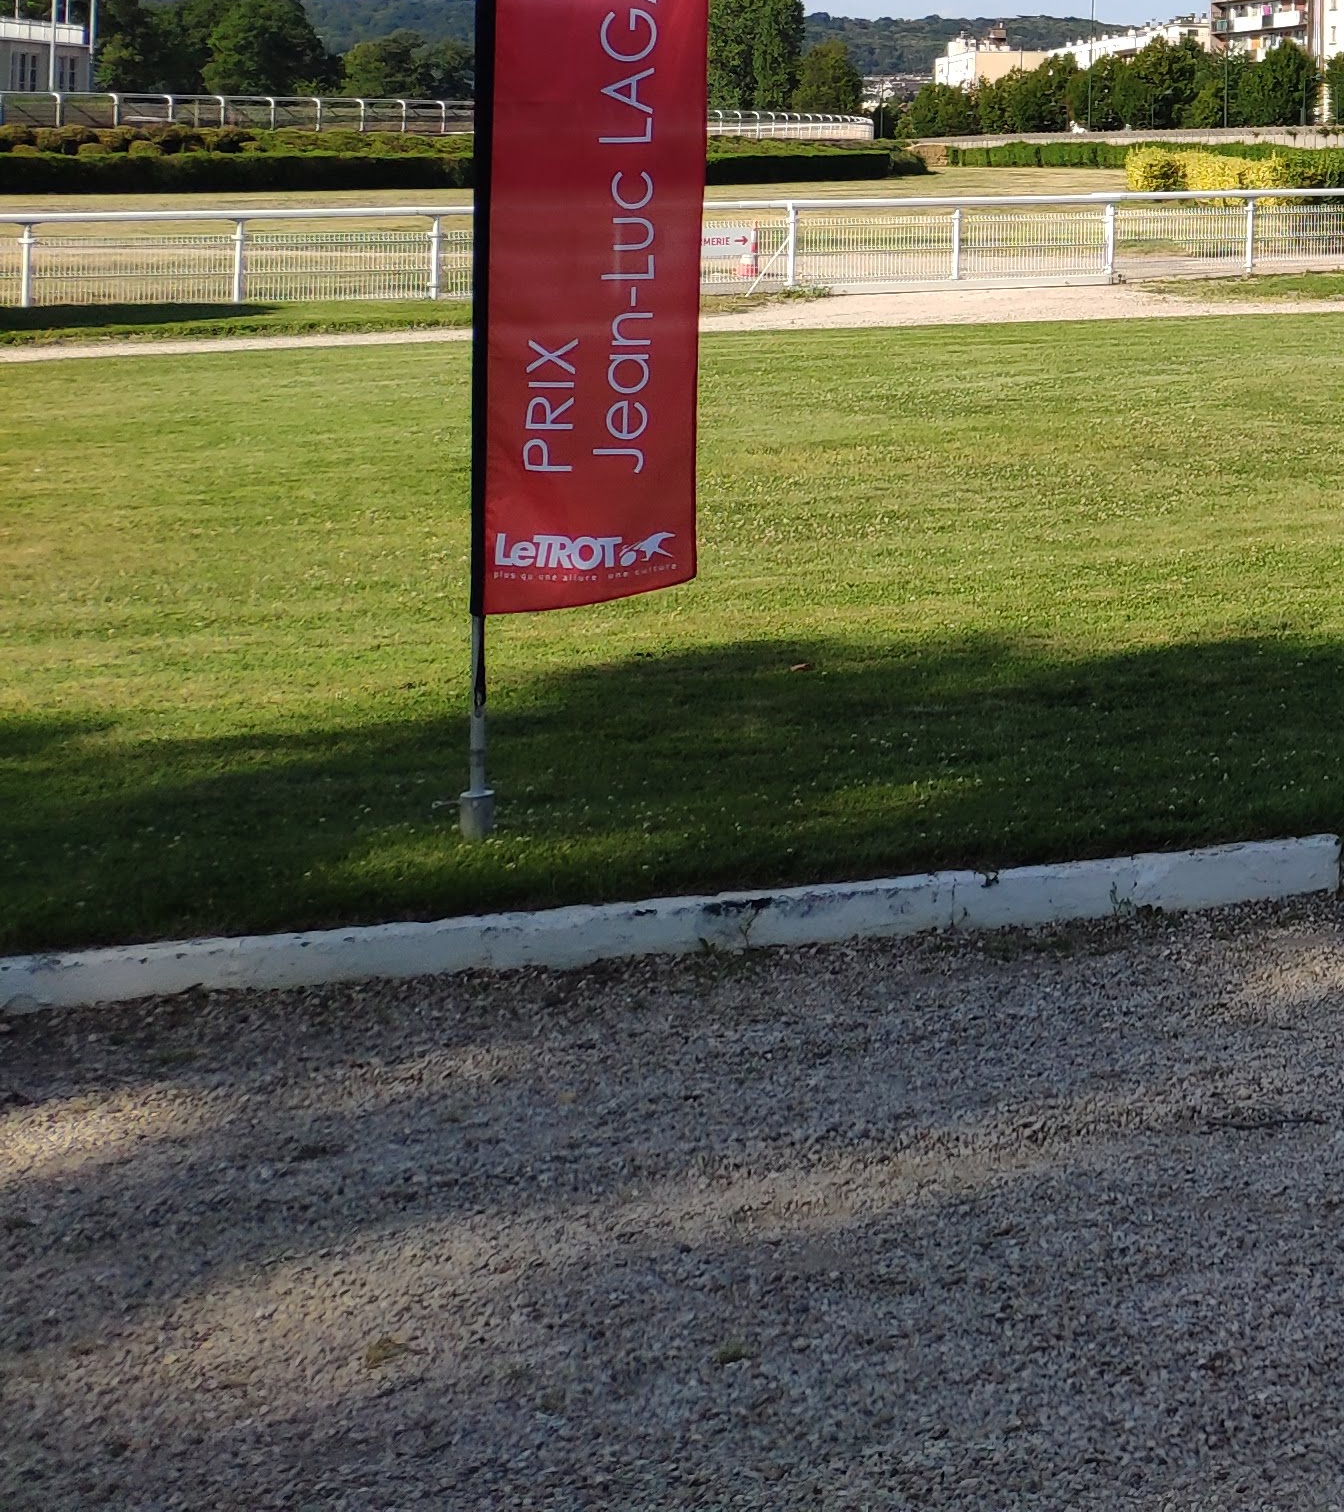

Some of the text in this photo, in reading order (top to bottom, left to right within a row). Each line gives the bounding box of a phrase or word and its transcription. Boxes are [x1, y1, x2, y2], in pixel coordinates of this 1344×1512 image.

[701, 237, 730, 245] MERIE
[592, 171, 654, 473] Jean-Luc
[523, 338, 578, 472] PRIX
[495, 533, 622, 570] LeTROT
